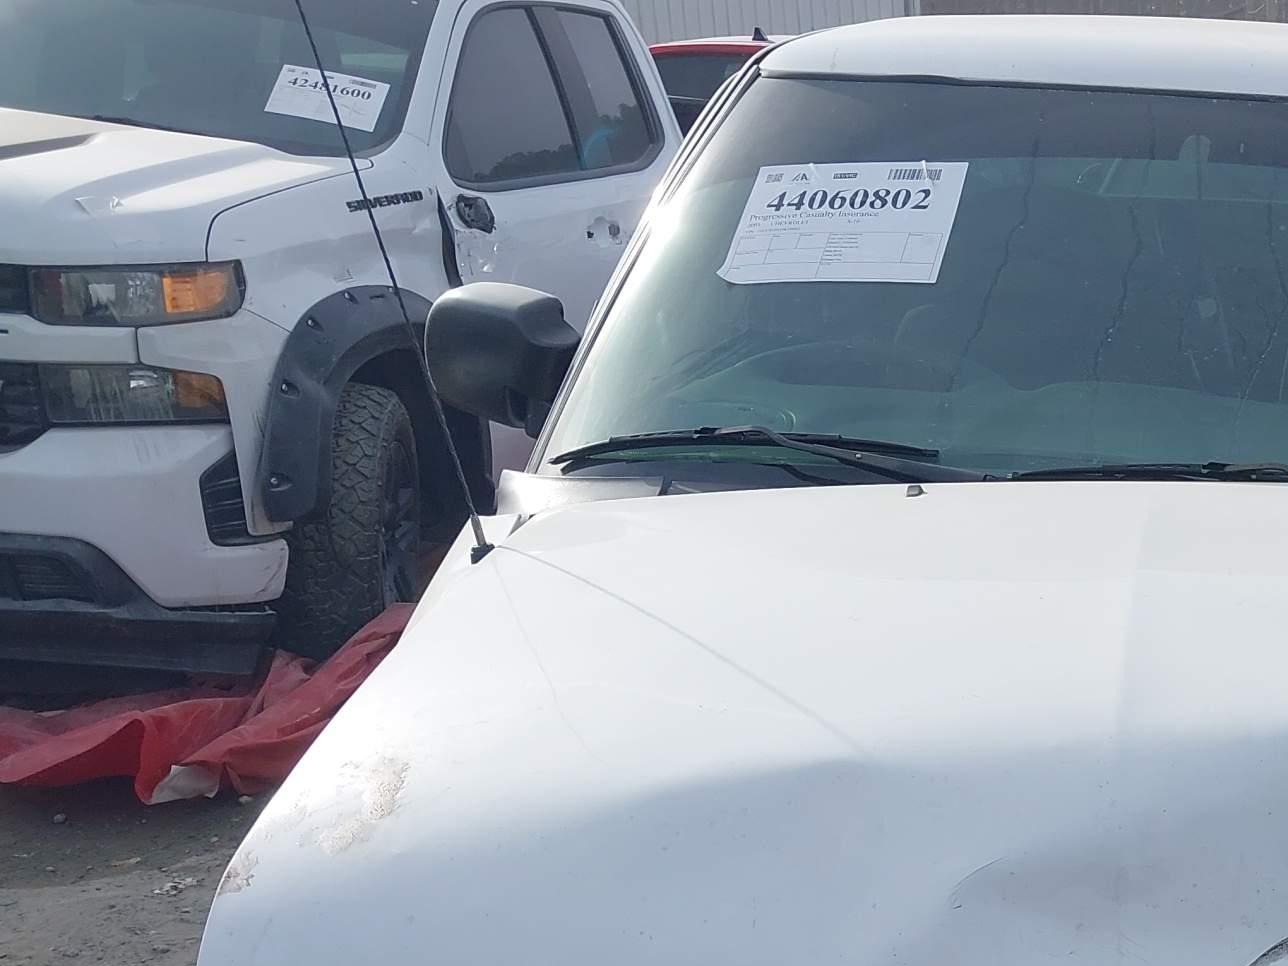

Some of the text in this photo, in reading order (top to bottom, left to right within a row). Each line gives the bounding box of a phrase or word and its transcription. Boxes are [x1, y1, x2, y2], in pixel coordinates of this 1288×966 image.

[766, 188, 931, 212] 44060802
[750, 213, 798, 222] Progressive
[800, 210, 834, 218] Casualty
